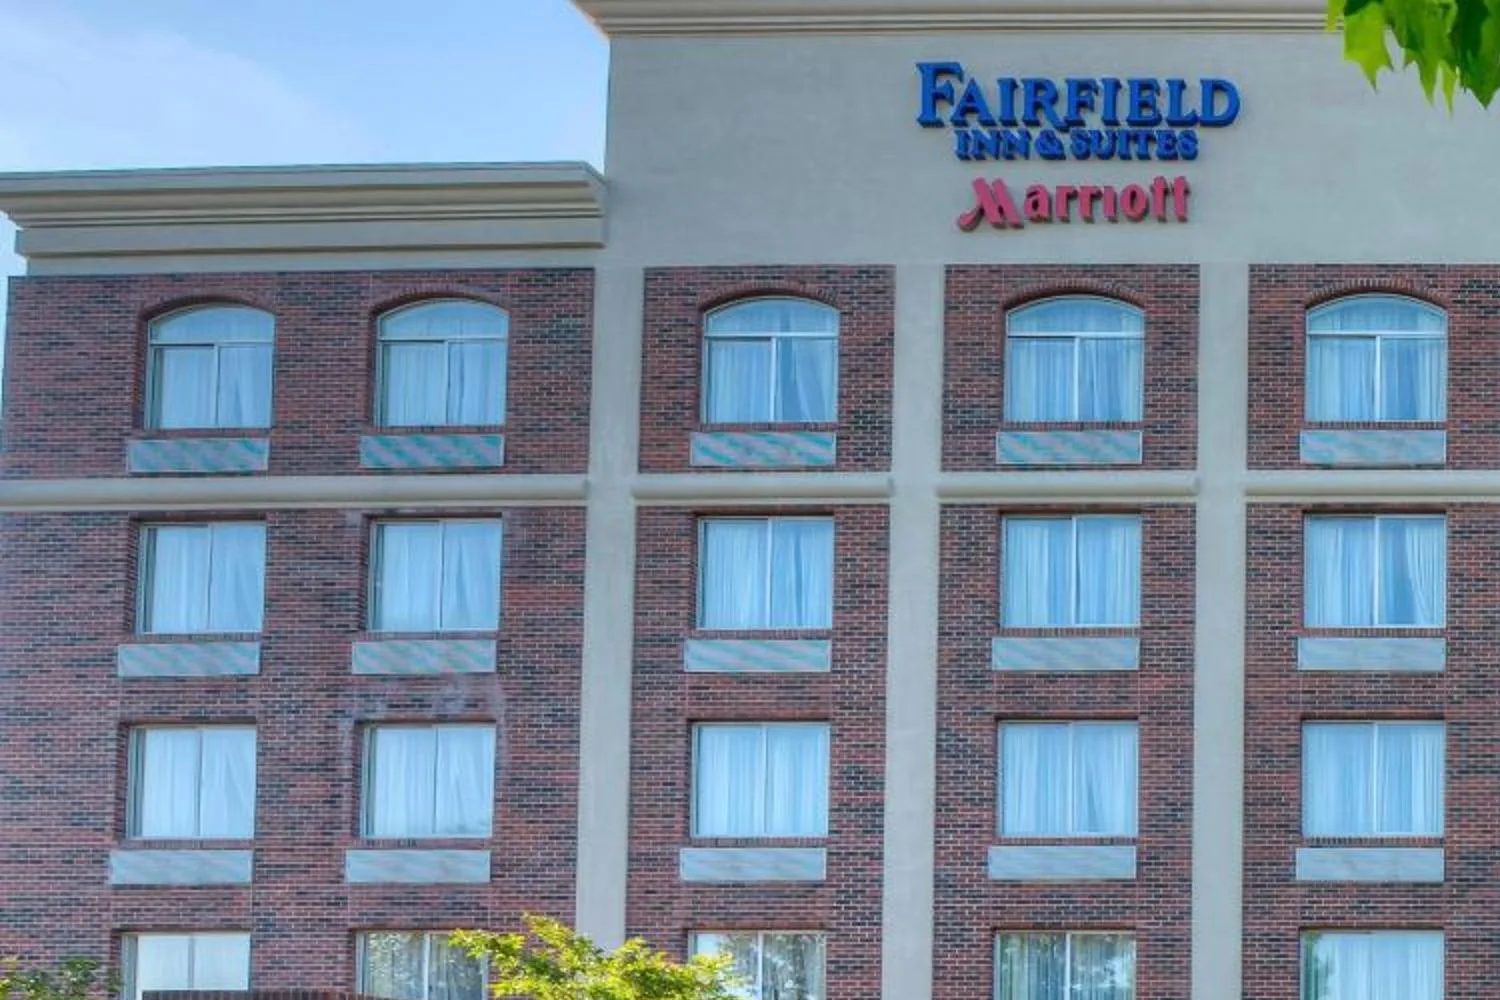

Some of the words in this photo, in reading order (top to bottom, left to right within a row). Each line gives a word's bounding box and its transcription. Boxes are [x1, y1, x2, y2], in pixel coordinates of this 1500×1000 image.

[915, 61, 1241, 132] FAIRFIELD
[954, 129, 1032, 161] INN
[1034, 129, 1067, 161] &
[1069, 129, 1199, 161] SUITES
[956, 175, 1190, 232] Marriott
